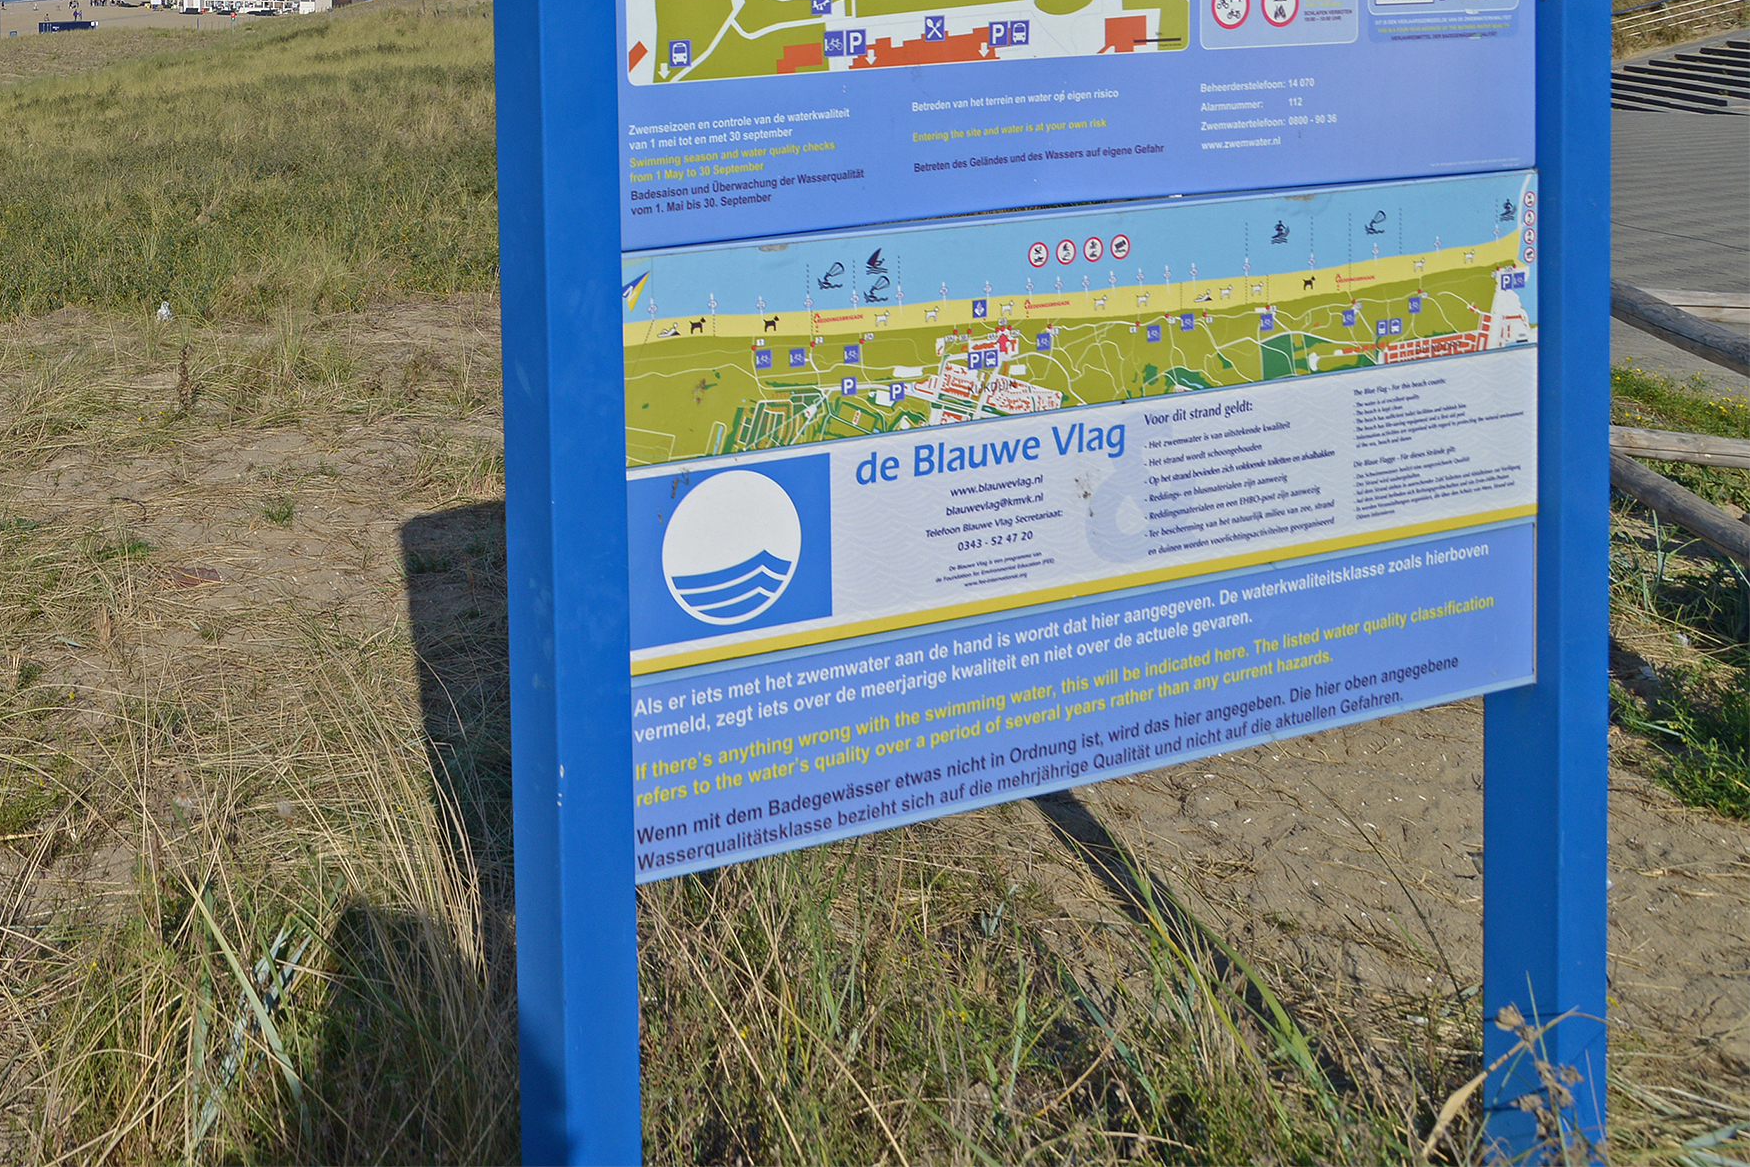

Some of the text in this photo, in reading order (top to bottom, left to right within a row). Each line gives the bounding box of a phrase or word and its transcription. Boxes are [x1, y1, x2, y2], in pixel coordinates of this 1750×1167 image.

[911, 88, 1119, 112] Betreden van het terrein en water op eigen risico
[1200, 96, 1302, 111] Alarmnummer: 112
[628, 107, 850, 135] Zwemseizoen en controle van de waterkwaliteit
[628, 127, 793, 150] van 1 mei tot en met 30 september
[1201, 136, 1281, 149] www.zwemwater.nl
[629, 141, 836, 168] Swimming season and water quality checks
[630, 162, 765, 182] from 1 May to 30 September
[1143, 399, 1252, 425] Voor dit strand geldt:
[855, 422, 1125, 485] de Blauwe Vlag
[950, 474, 1043, 496] www.blauwevlag.nl
[946, 492, 1043, 516] blauwevlag@kmvk.nl
[925, 509, 1063, 537] Telefoon Blauwe Vlag Secretariaat:
[957, 538, 982, 551] 0343
[991, 535, 1002, 546] 52
[1005, 533, 1017, 542] 47
[1021, 530, 1033, 541] 20
[633, 544, 1488, 717] Als er iets met het zwemwater aan de hand is wordt dat hier aangegeven. De waterkwaliteitsklasse zoals hierboven
[634, 612, 1252, 742] vermeld, zegt iets over de meerjarige kwaliteit en niet over de actuele gevaren.
[637, 691, 1403, 870] Wasserqualitätsklasse bezieht sich auf die mehrjährige Qualität und nicht auf die aktuellen Gefahren.
